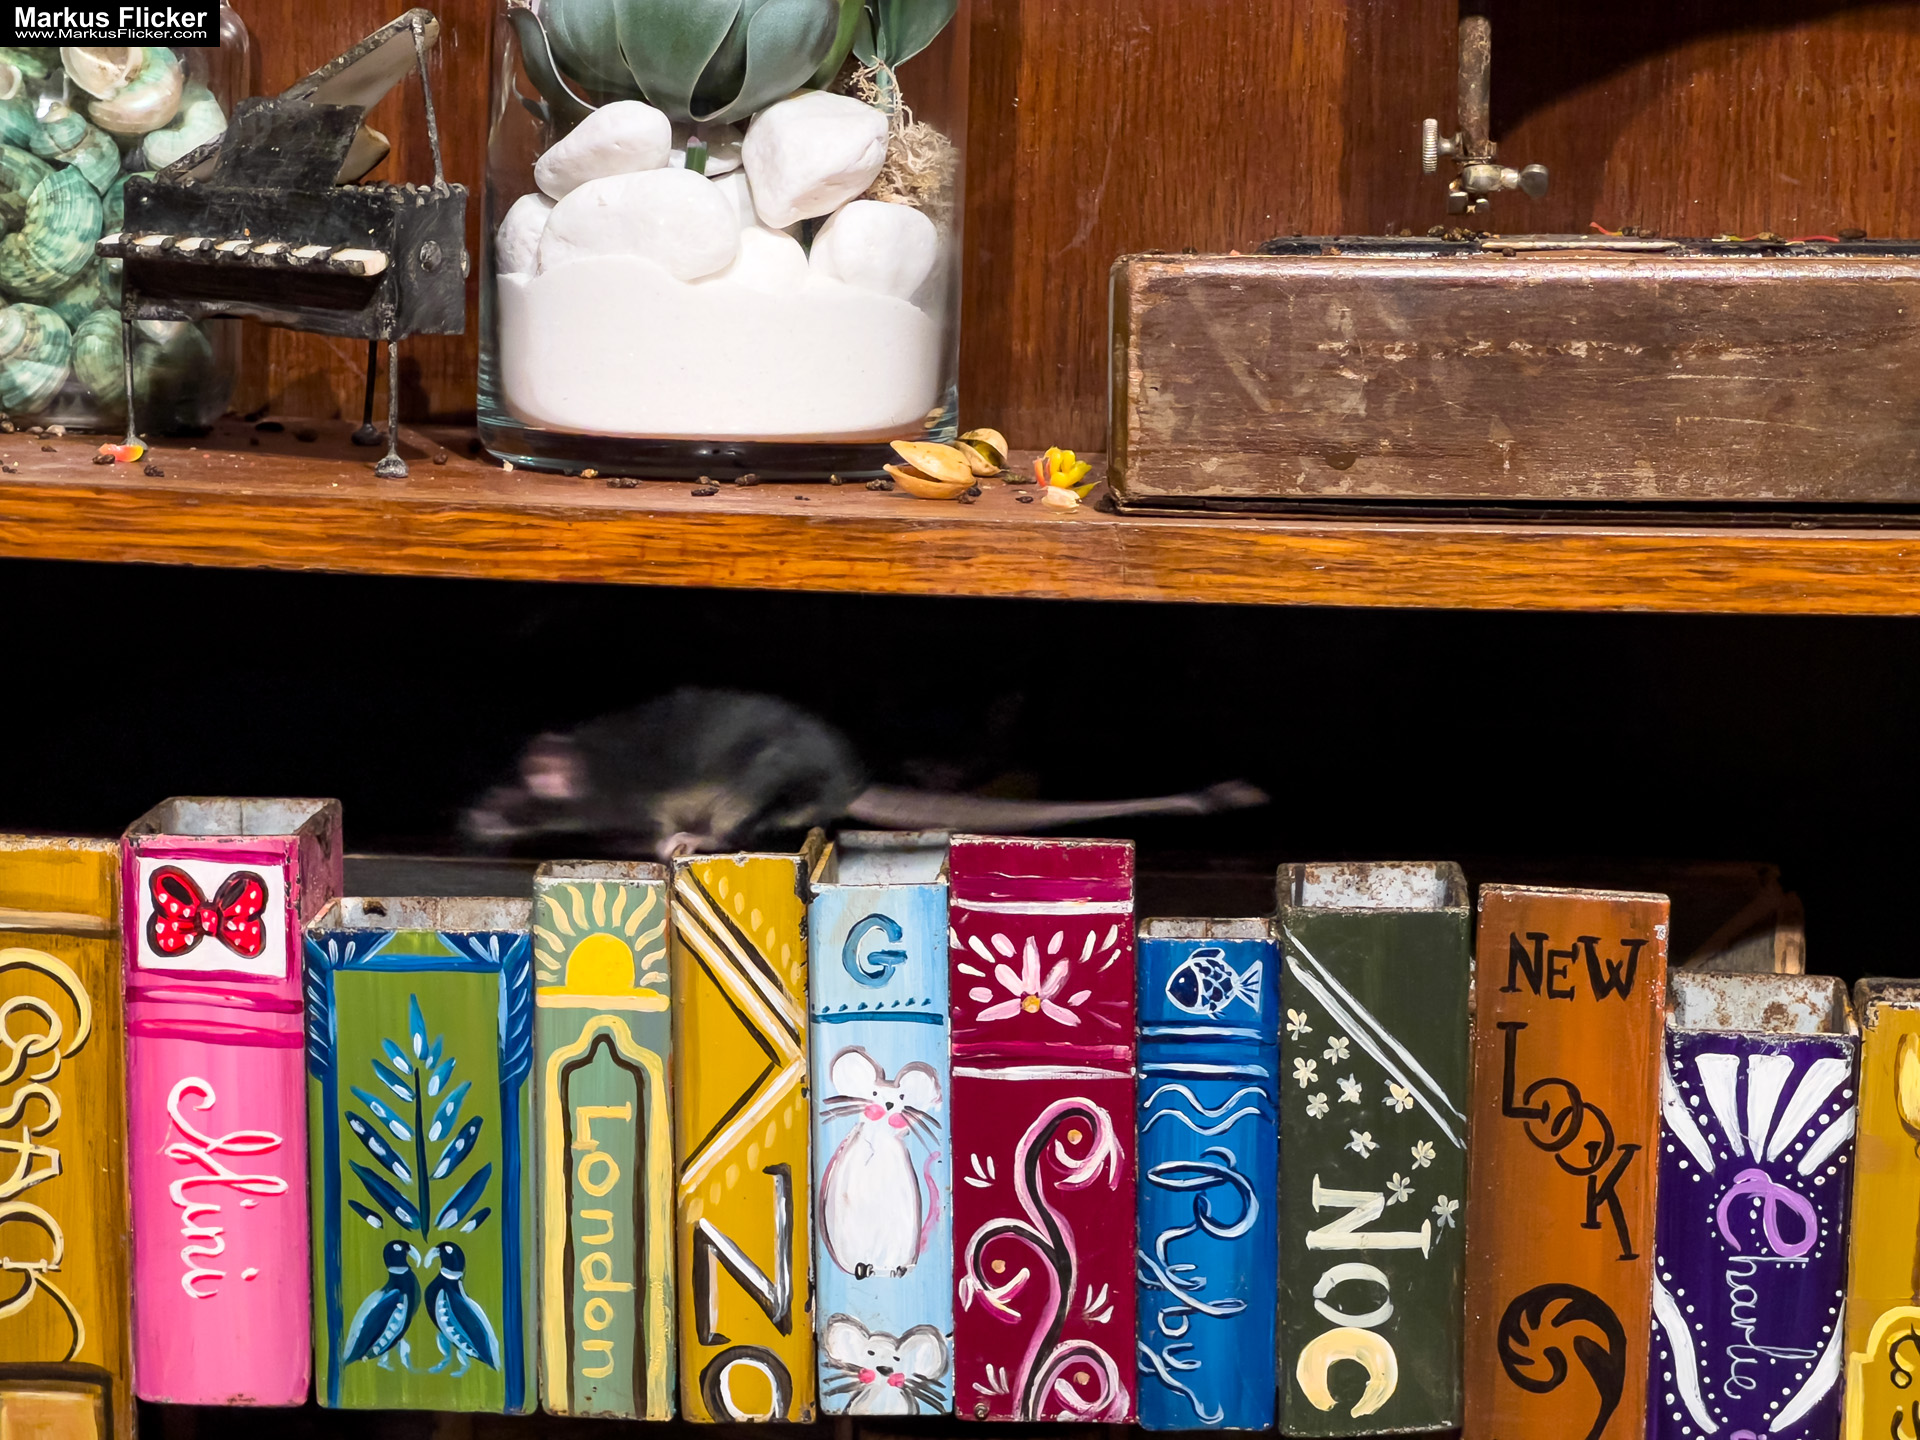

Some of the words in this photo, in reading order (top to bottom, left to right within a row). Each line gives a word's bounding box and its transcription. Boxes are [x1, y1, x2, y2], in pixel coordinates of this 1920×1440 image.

[843, 913, 907, 988] G
[1499, 930, 1649, 1002] NEW
[570, 1100, 636, 1378] London
[1496, 1020, 1643, 1262] LOOK
[1138, 1145, 1260, 1425] Ruby
